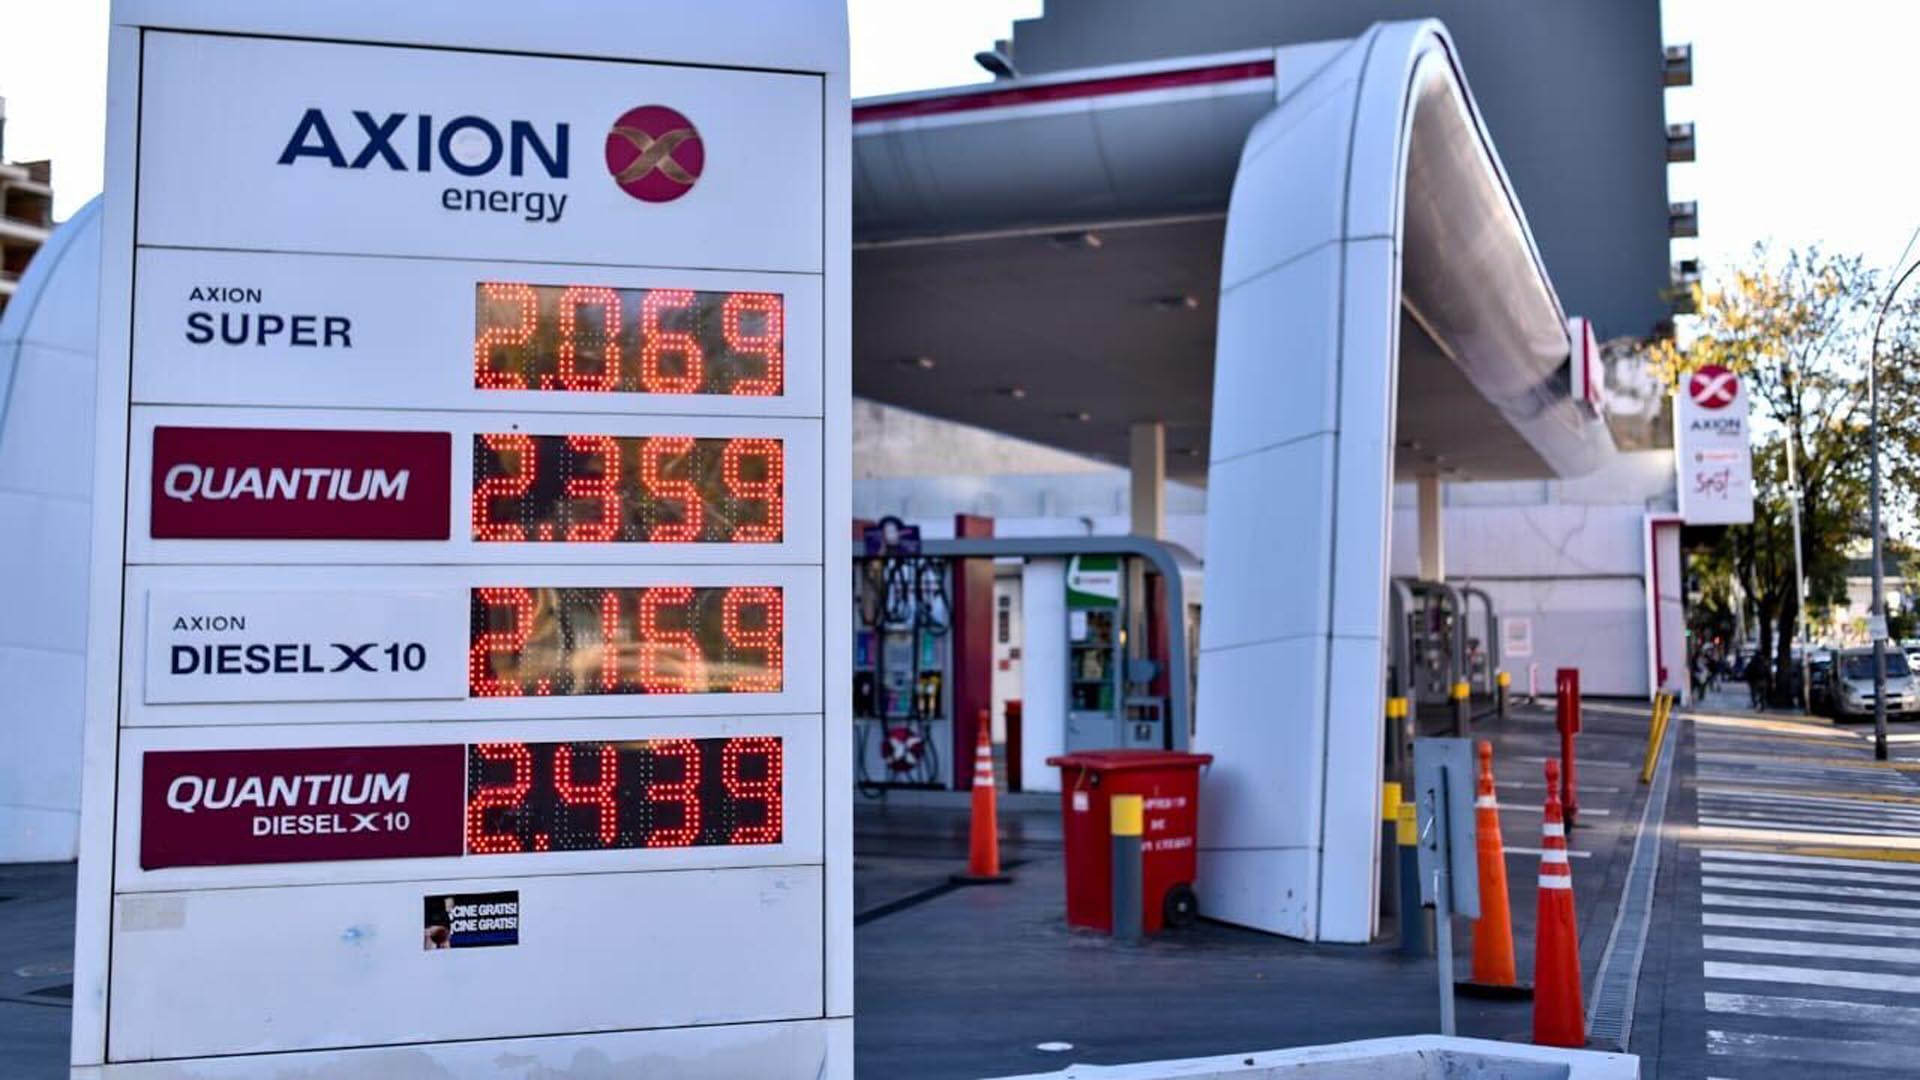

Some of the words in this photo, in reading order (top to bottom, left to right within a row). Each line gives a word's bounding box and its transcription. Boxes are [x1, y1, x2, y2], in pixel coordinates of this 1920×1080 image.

[277, 107, 570, 180] AXION
[441, 188, 568, 223] energy
[188, 287, 262, 304] AXION
[185, 312, 353, 348] SUPER
[475, 283, 784, 395] 2.069
[163, 463, 410, 502] QUANTIUM
[472, 434, 784, 543] 2.359
[173, 616, 246, 631] AXION
[470, 586, 784, 697] 2.169
[166, 773, 410, 813] QUANTIUM
[468, 738, 784, 852] 2.439
